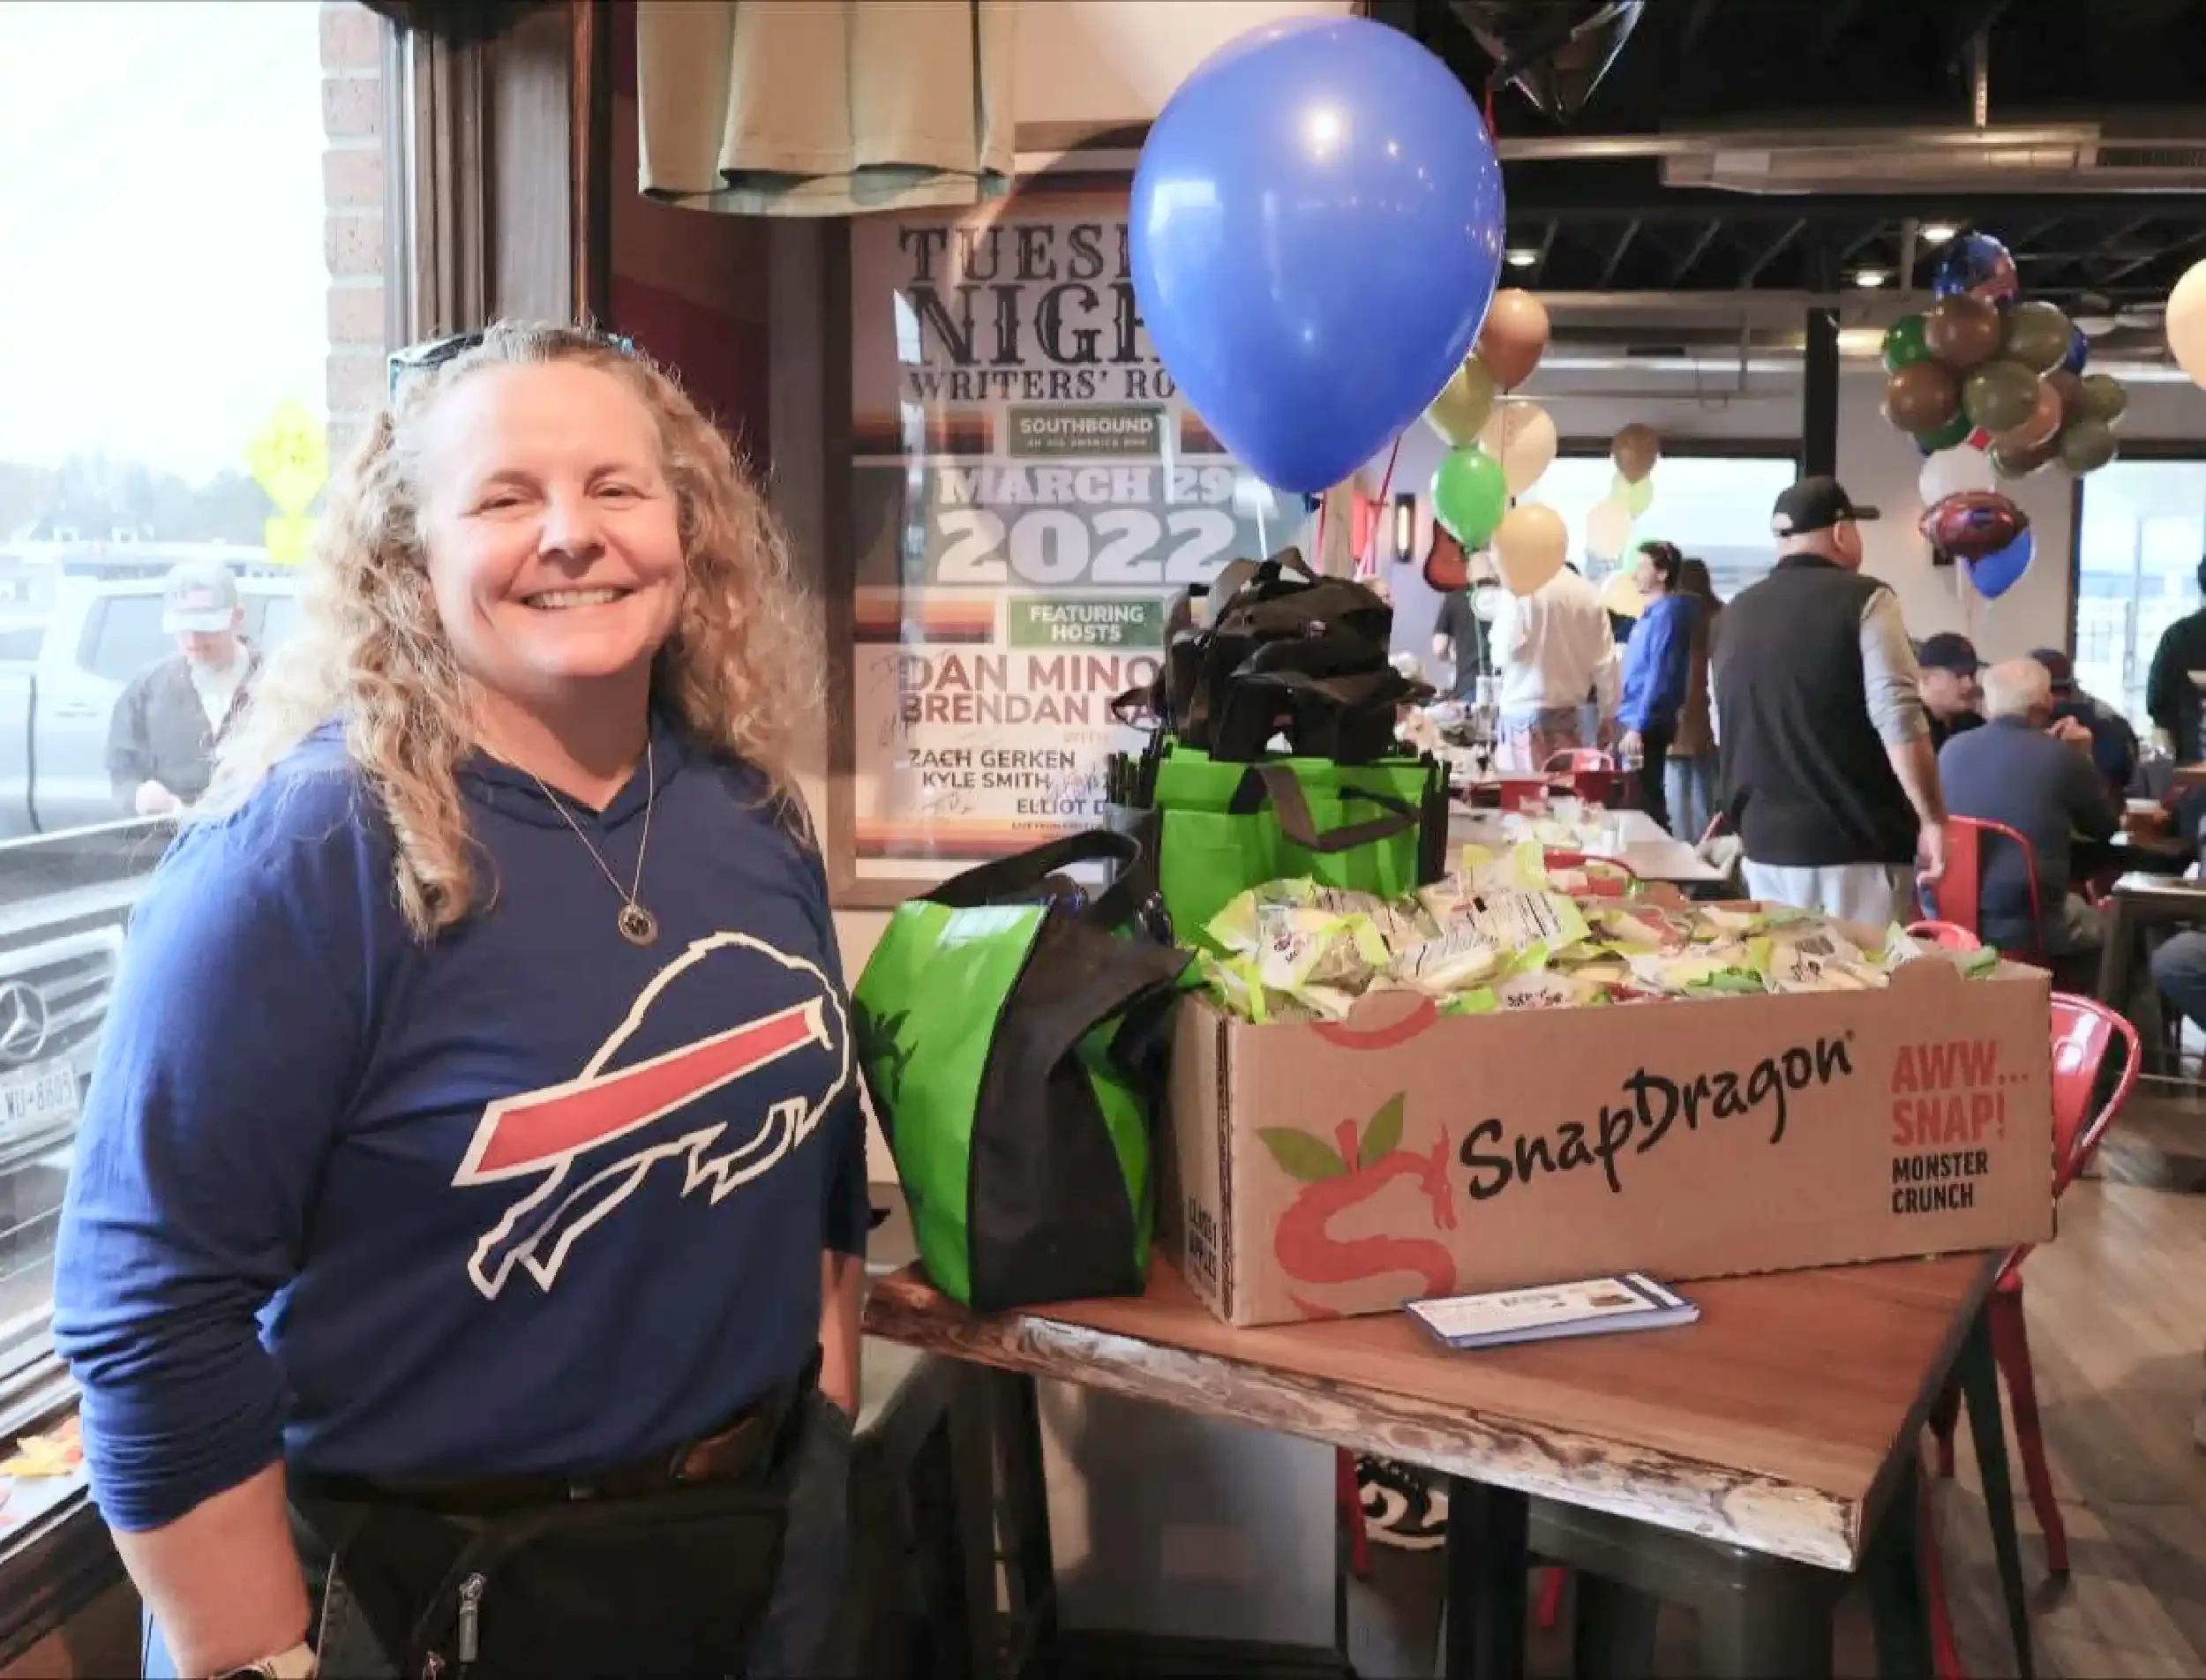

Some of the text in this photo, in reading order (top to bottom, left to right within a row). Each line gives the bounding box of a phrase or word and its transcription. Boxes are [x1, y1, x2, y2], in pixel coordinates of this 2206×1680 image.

[909, 368, 1107, 400] WRITERS'
[1020, 416, 1153, 434] SOUTHBOUND
[937, 467, 1233, 504] MARCH 29
[936, 509, 1234, 583] 2022
[1031, 604, 1144, 622] FEATURING
[1051, 624, 1122, 642] HOSTS
[899, 654, 1008, 691] DAN
[900, 693, 1090, 724] BRENDAN
[908, 749, 1077, 769] ZACH GERKEN
[923, 772, 1048, 789] KYLE SMITH
[1017, 799, 1087, 815] ELLIOT
[1891, 1039, 2029, 1093] AWW...
[1459, 1034, 1852, 1200] SnapDragon
[1891, 1090, 2005, 1146] SNAP!
[1891, 1150, 1989, 1184] MONSTER
[1892, 1181, 1975, 1215] CRUNCH
